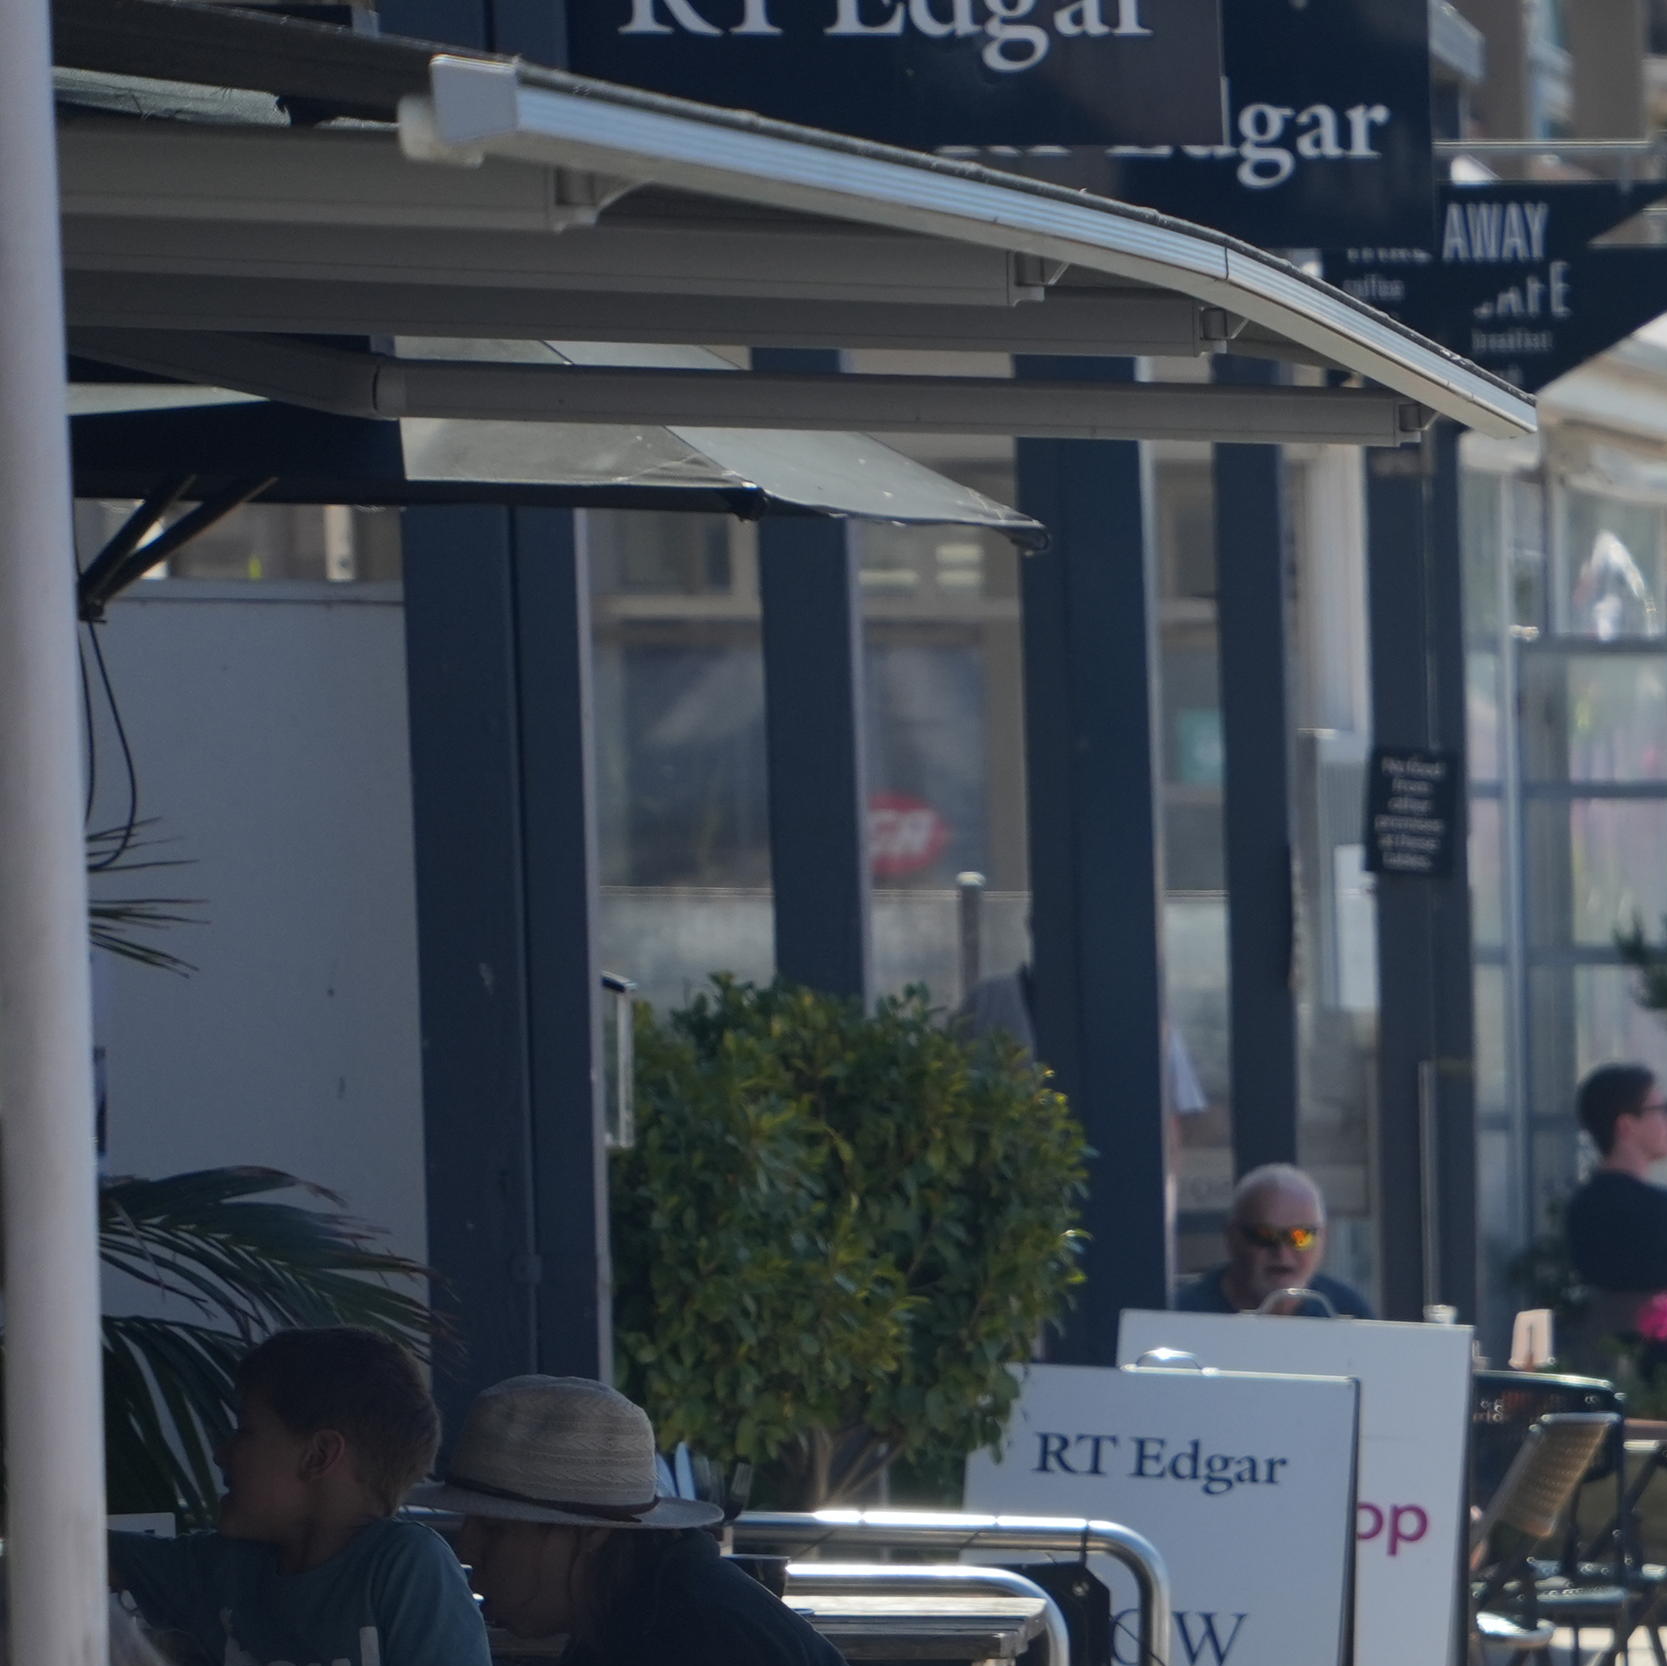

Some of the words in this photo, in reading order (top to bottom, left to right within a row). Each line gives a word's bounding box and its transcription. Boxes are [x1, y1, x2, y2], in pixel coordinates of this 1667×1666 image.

[1442, 201, 1550, 264] AWAY
[1472, 260, 1572, 317] AFE
[1031, 1431, 1119, 1476] RT
[1126, 1436, 1288, 1496] Edgar
